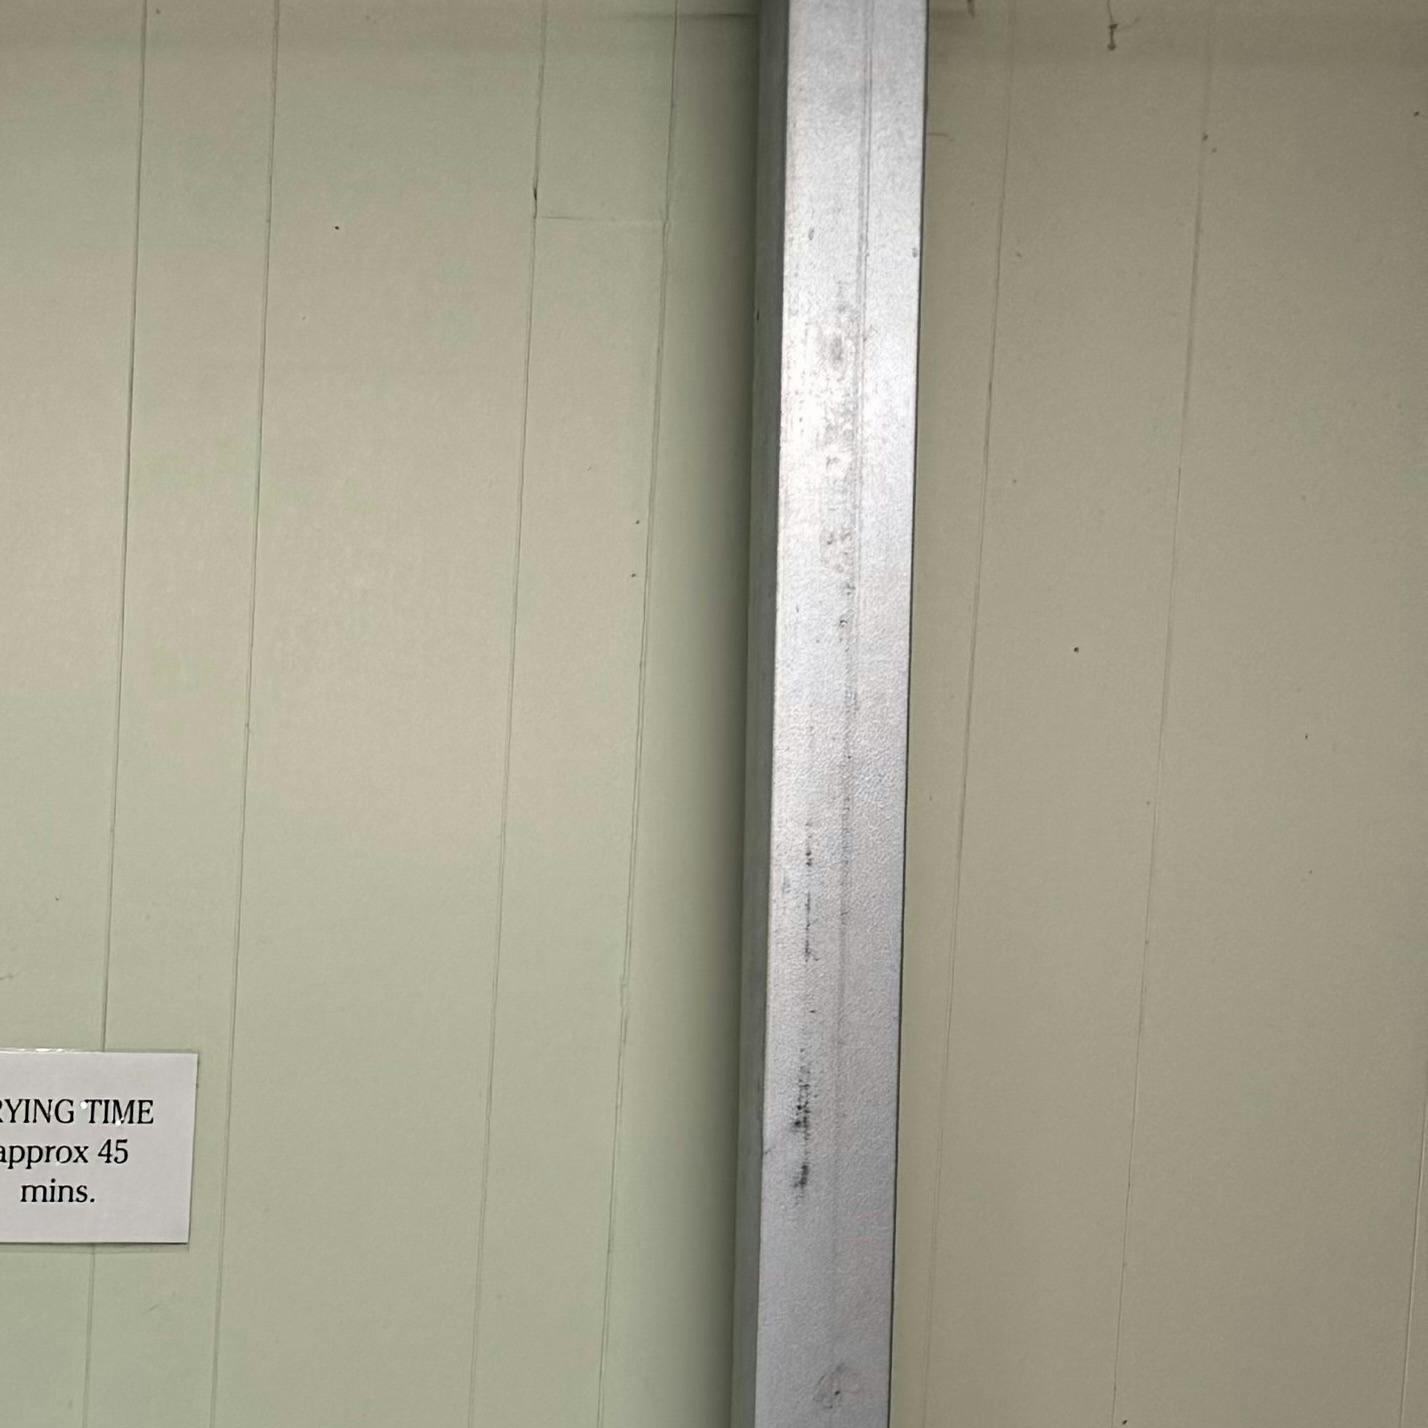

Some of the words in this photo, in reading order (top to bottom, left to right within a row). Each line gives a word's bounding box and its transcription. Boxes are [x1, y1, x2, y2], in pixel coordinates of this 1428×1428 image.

[84, 1098, 155, 1125] TIME
[97, 1138, 129, 1165] 45
[19, 1178, 96, 1204] mins.
